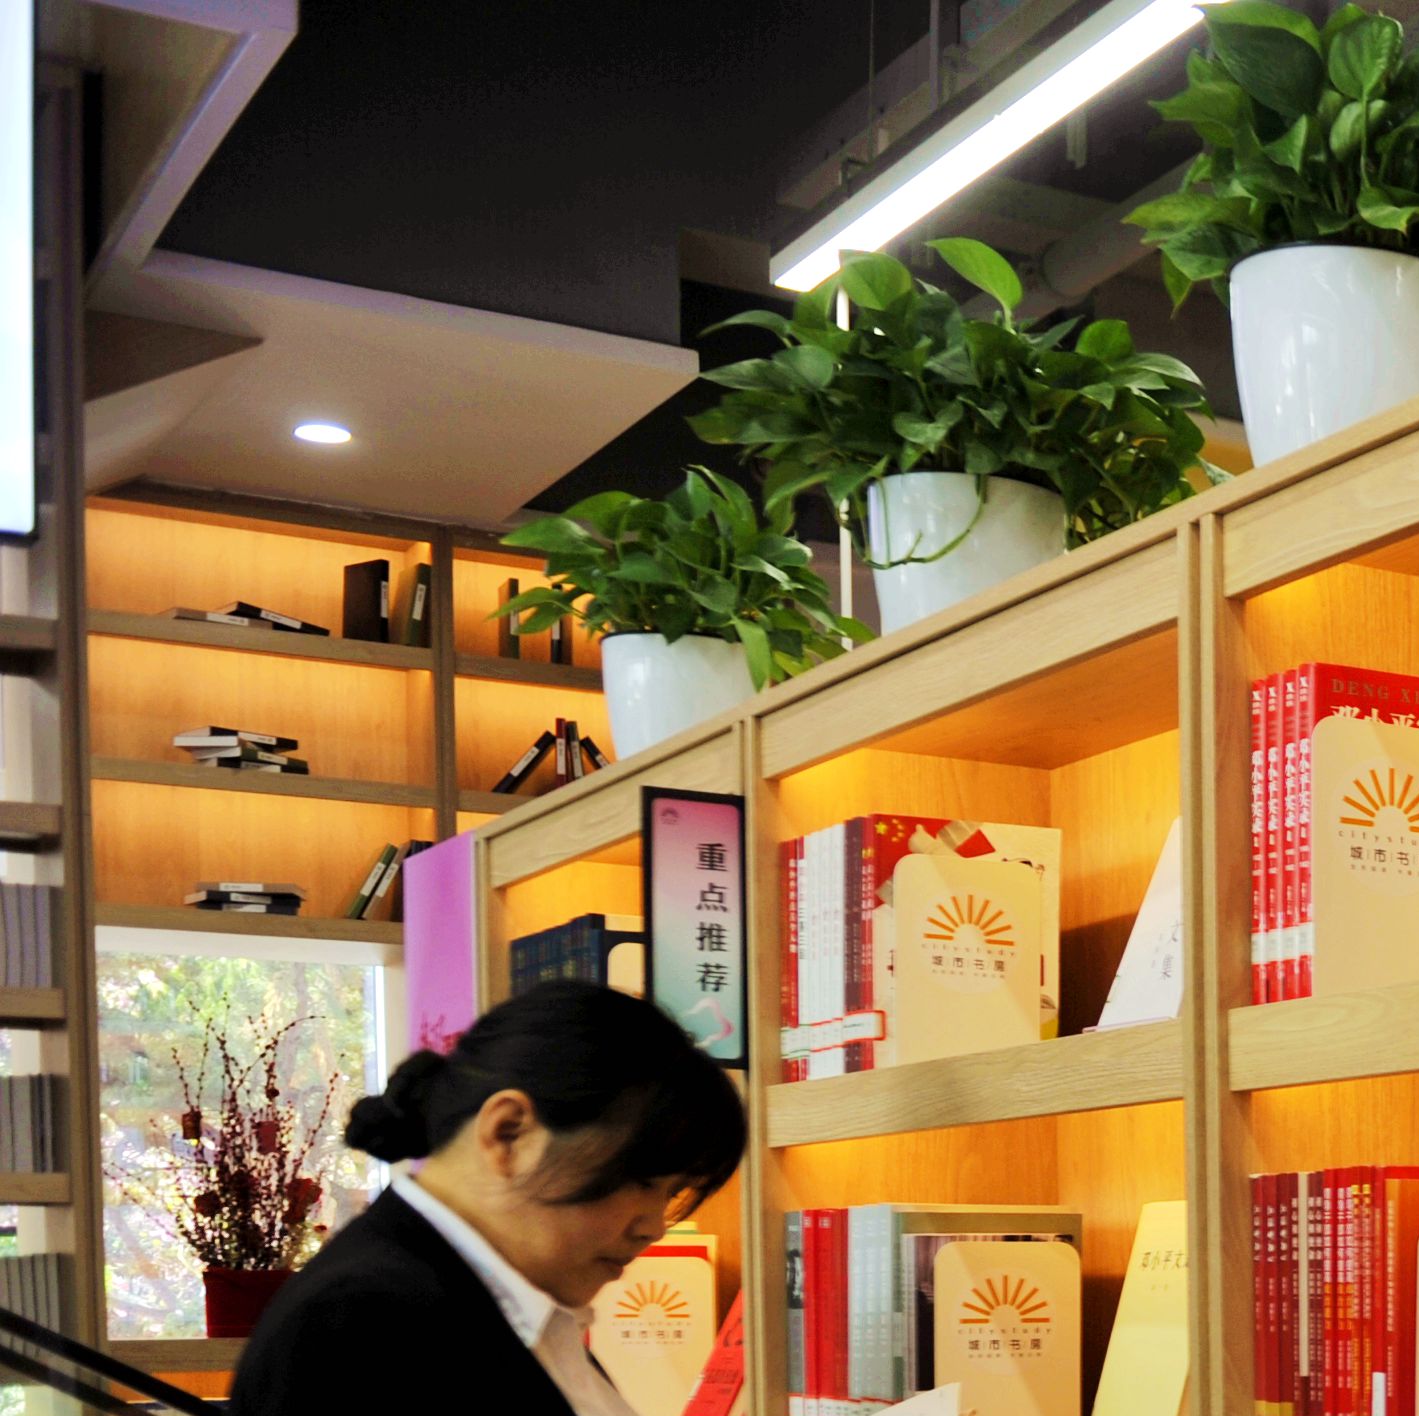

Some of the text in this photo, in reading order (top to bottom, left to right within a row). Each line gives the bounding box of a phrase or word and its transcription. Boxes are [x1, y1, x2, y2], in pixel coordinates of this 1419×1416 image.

[1330, 678, 1391, 700] DENG
[695, 842, 729, 993] 重点推荐
